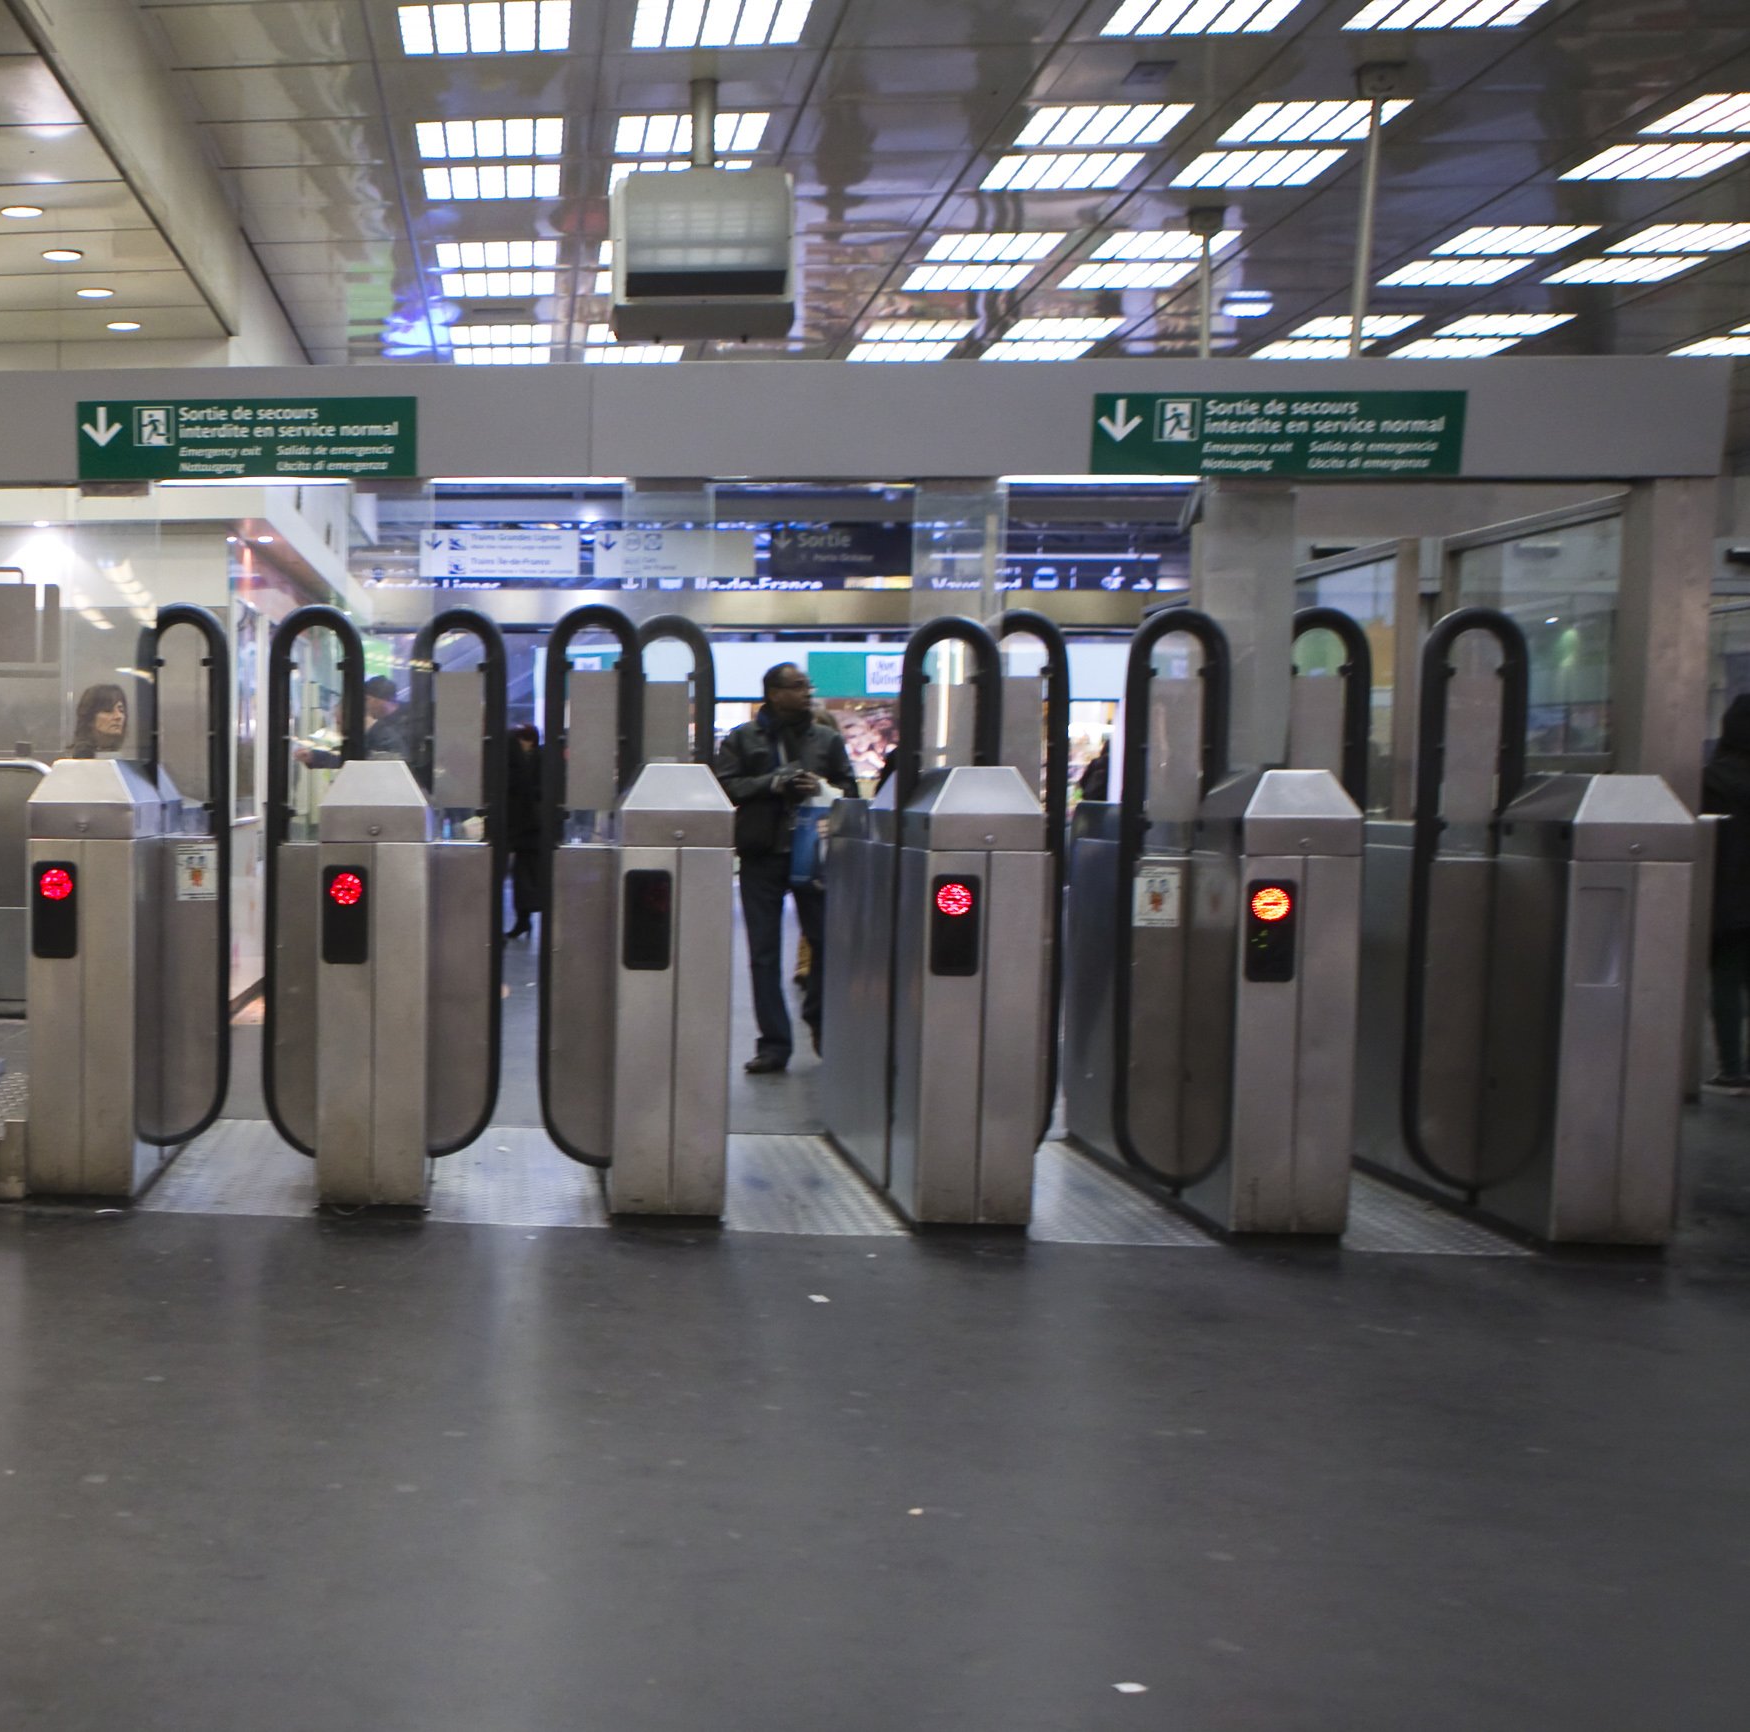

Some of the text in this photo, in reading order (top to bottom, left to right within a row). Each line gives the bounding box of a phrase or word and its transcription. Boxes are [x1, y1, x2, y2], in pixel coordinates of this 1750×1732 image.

[178, 406, 319, 421] Sortie de secours
[1204, 399, 1359, 416] Sortie de secours
[178, 421, 399, 438] interdite en service normal
[1204, 415, 1446, 434] interdite en service normal
[178, 446, 262, 459] Emergency exit
[276, 444, 395, 457] Salida de emergencia
[1201, 441, 1294, 456] Emergency exit
[1366, 440, 1440, 455] emergencia
[178, 462, 246, 475] Notausgang
[1200, 458, 1275, 472] Notausgang
